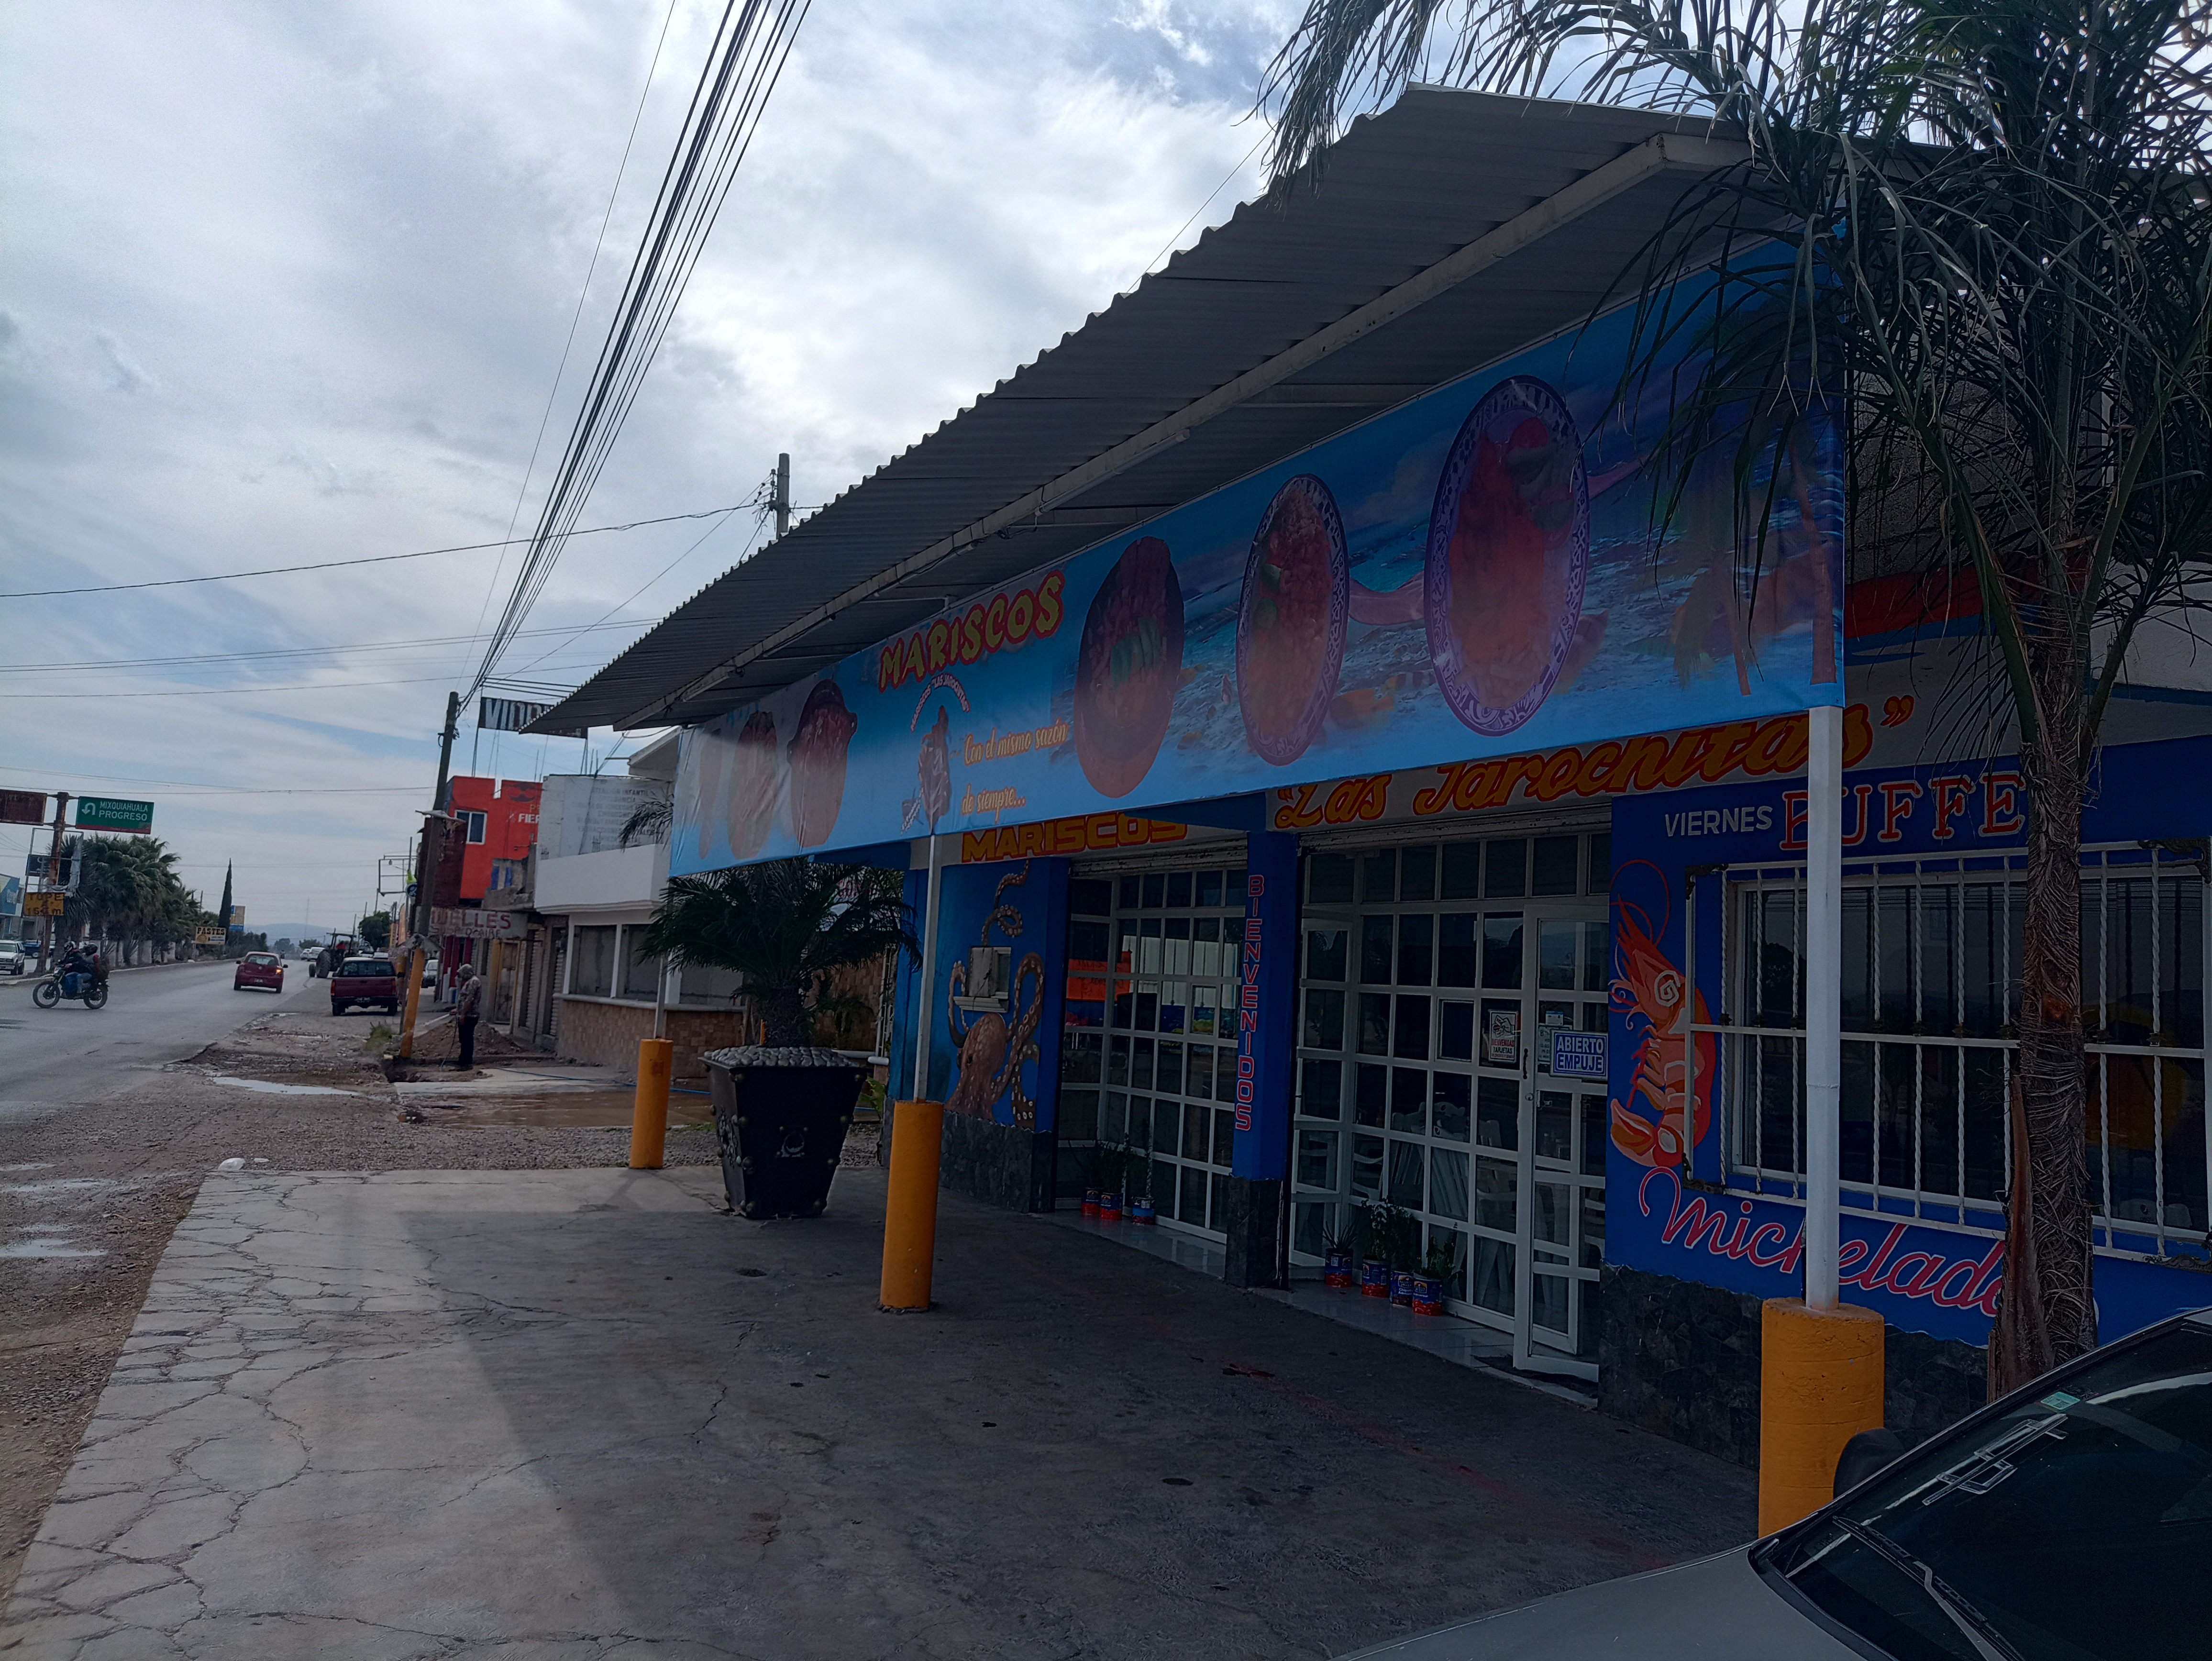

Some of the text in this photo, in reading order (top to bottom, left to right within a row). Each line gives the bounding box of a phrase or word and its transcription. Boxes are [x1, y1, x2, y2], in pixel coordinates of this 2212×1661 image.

[878, 570, 1066, 694] MARISCOS
[964, 718, 1070, 767] Con el mismo sazón
[99, 810, 147, 821] PROGRESO
[961, 783, 975, 816] de
[962, 812, 1187, 863] MARISCOS
[1665, 806, 1773, 838] VIERNES
[1235, 875, 1265, 1131] BIENVENIDOS
[1557, 1036, 1604, 1054] ABIERTO
[1558, 1054, 1603, 1071] EMPUJE
